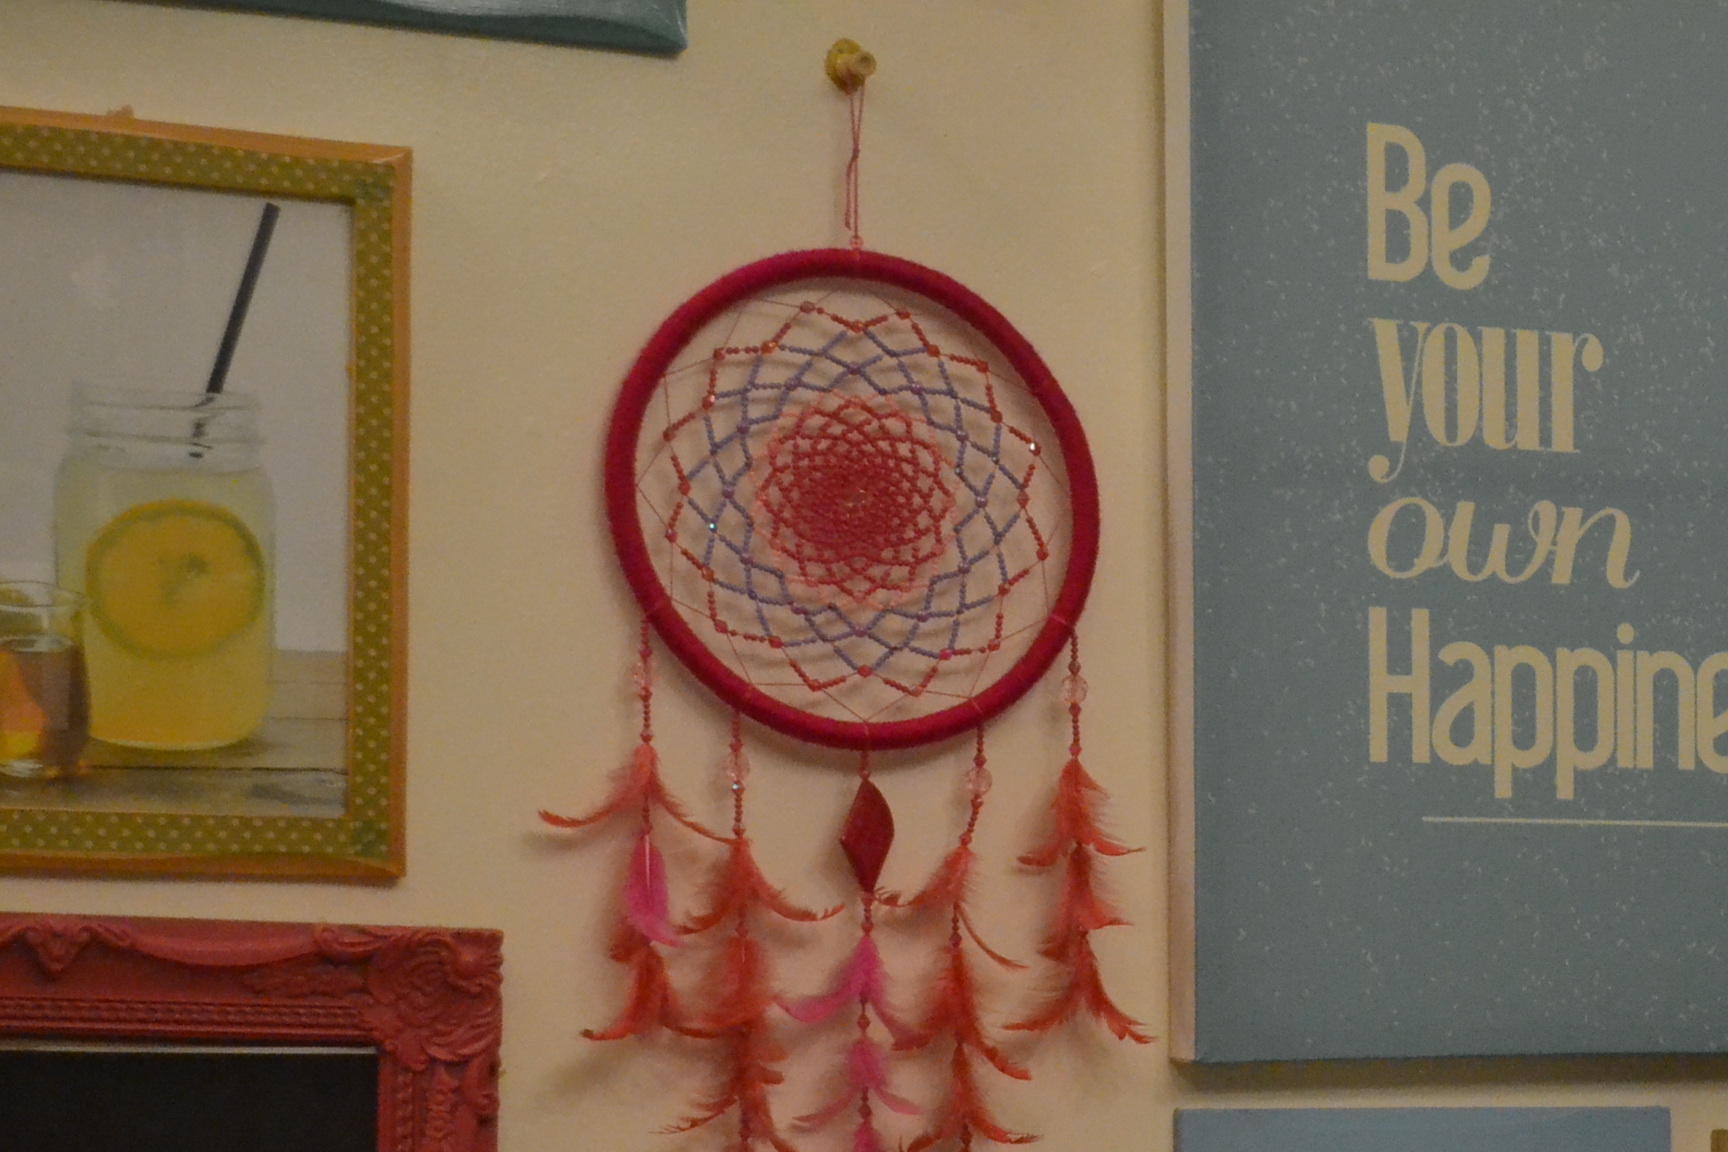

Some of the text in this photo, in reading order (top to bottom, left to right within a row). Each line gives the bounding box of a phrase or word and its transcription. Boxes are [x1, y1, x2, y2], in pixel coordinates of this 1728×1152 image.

[1367, 122, 1491, 290] Be
[1367, 318, 1604, 483] your
[1367, 497, 1641, 589] own
